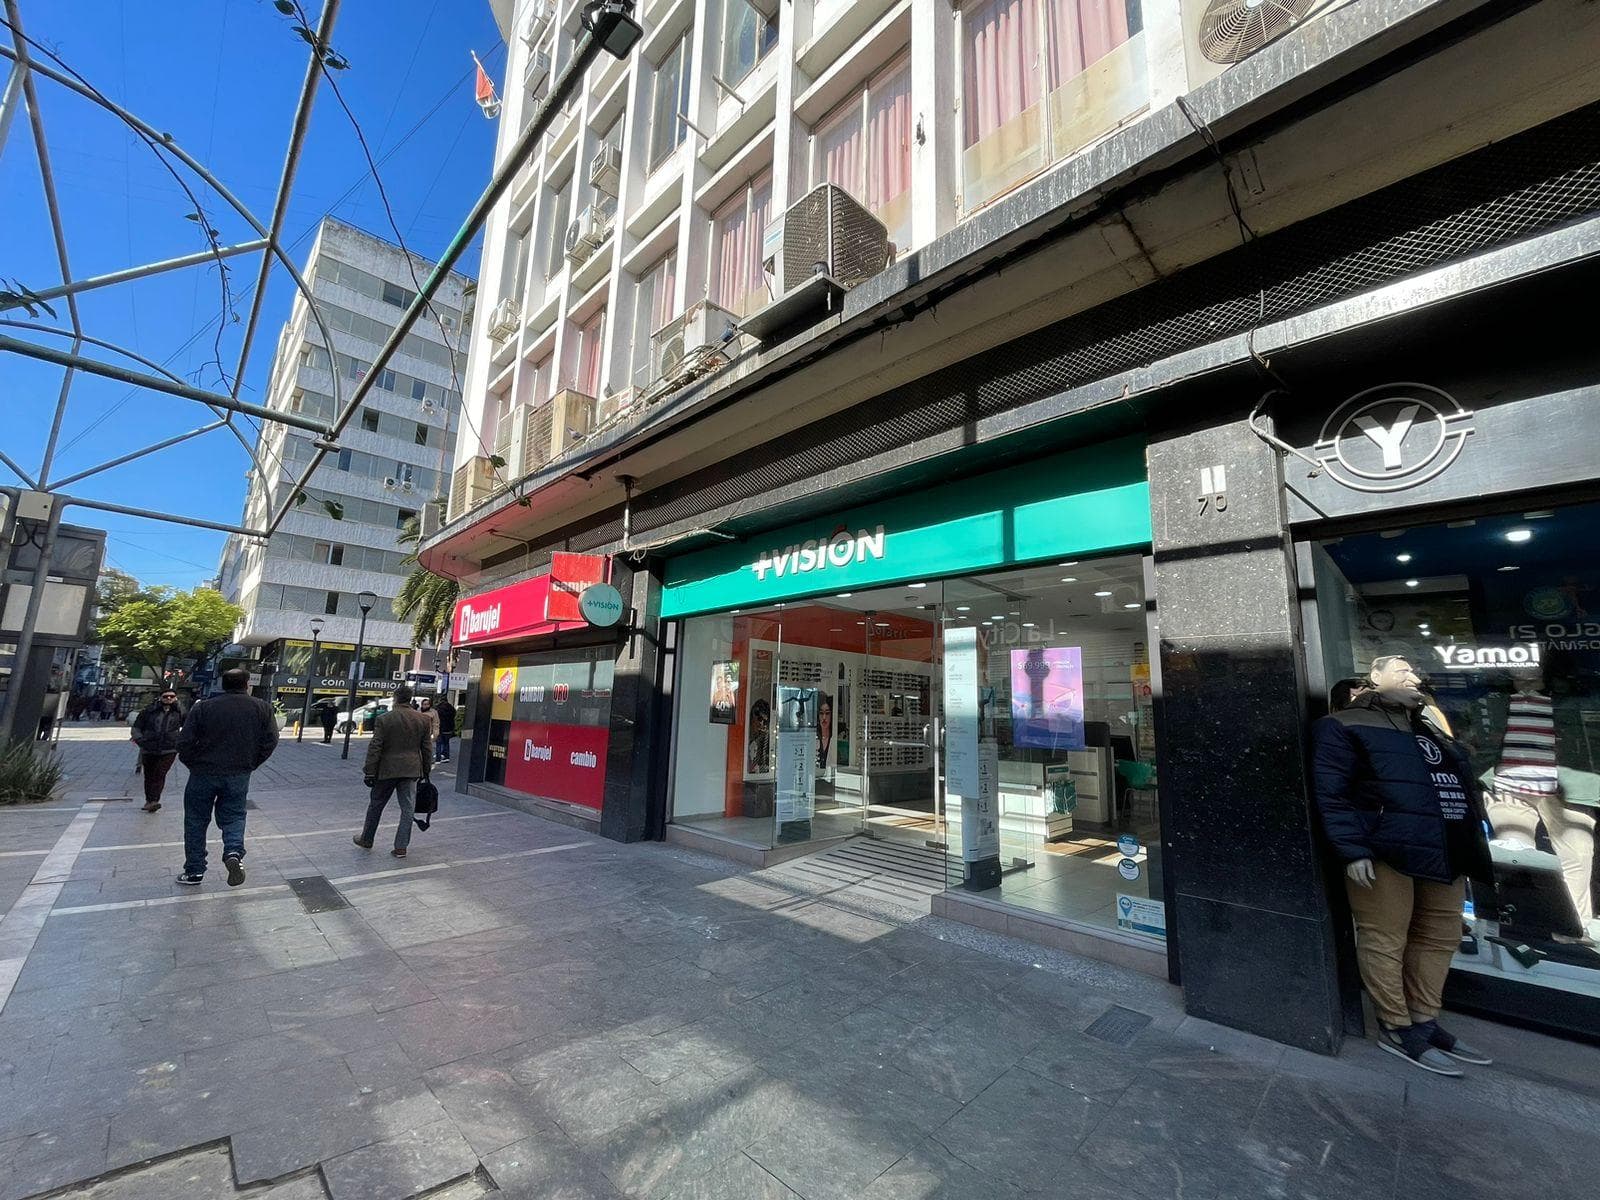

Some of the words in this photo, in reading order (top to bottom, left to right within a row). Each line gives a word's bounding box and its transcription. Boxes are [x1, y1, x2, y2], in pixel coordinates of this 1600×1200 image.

[1352, 404, 1421, 471] Y
[1196, 494, 1228, 517] 70
[469, 602, 501, 634] barujel
[1434, 642, 1540, 664] Yamoi
[321, 678, 346, 687] COIN
[520, 685, 545, 703] CAMBIO
[553, 683, 570, 702] ORO
[531, 744, 552, 761] barujel
[570, 751, 597, 768] cambio
